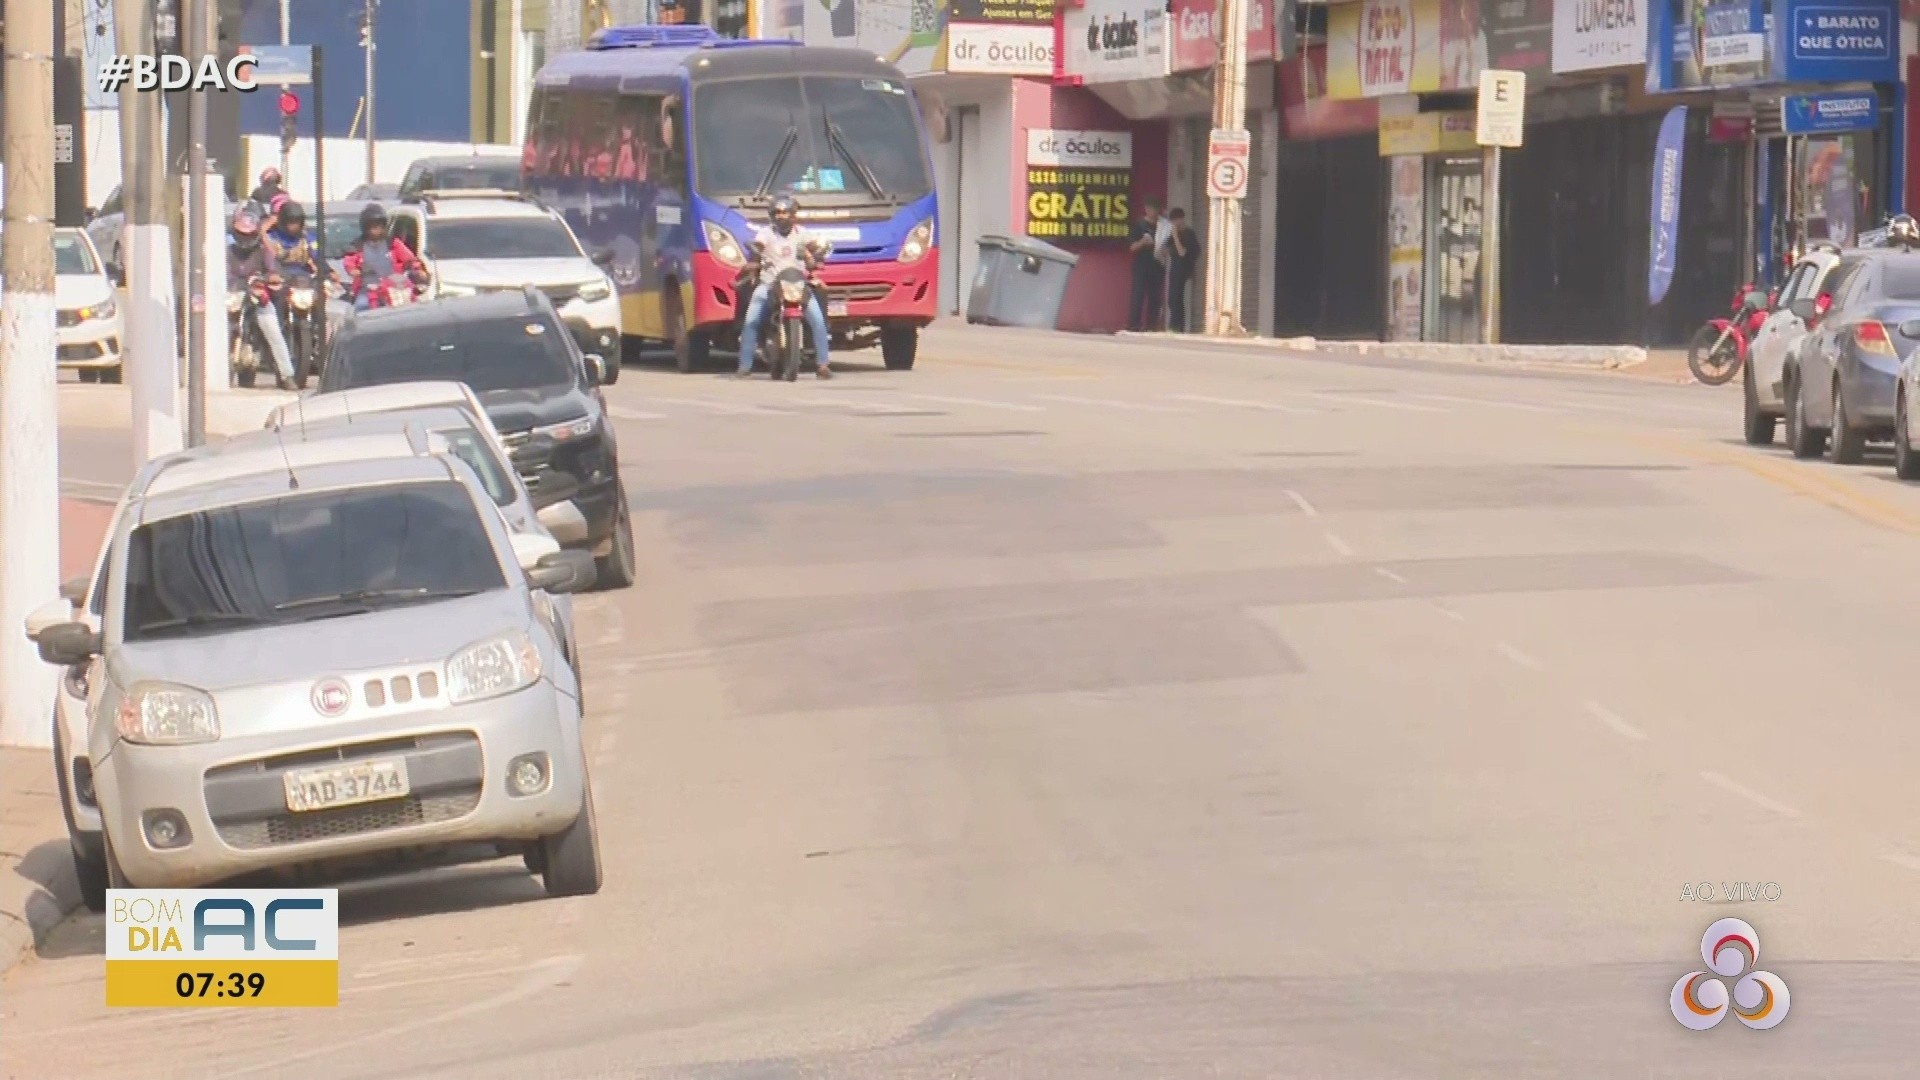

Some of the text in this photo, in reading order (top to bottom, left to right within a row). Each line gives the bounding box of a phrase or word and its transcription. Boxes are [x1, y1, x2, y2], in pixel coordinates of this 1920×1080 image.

[1575, 0, 1636, 33] LUMERA
[1818, 16, 1881, 30] BARATO
[955, 38, 980, 60] dr.
[1799, 33, 1885, 50] QUE ÓTICA
[1496, 80, 1509, 102] E
[1039, 136, 1060, 154] dr.
[1029, 170, 1131, 187] ESTACIONAMENTO
[1028, 186, 1129, 219] GRÁTIS
